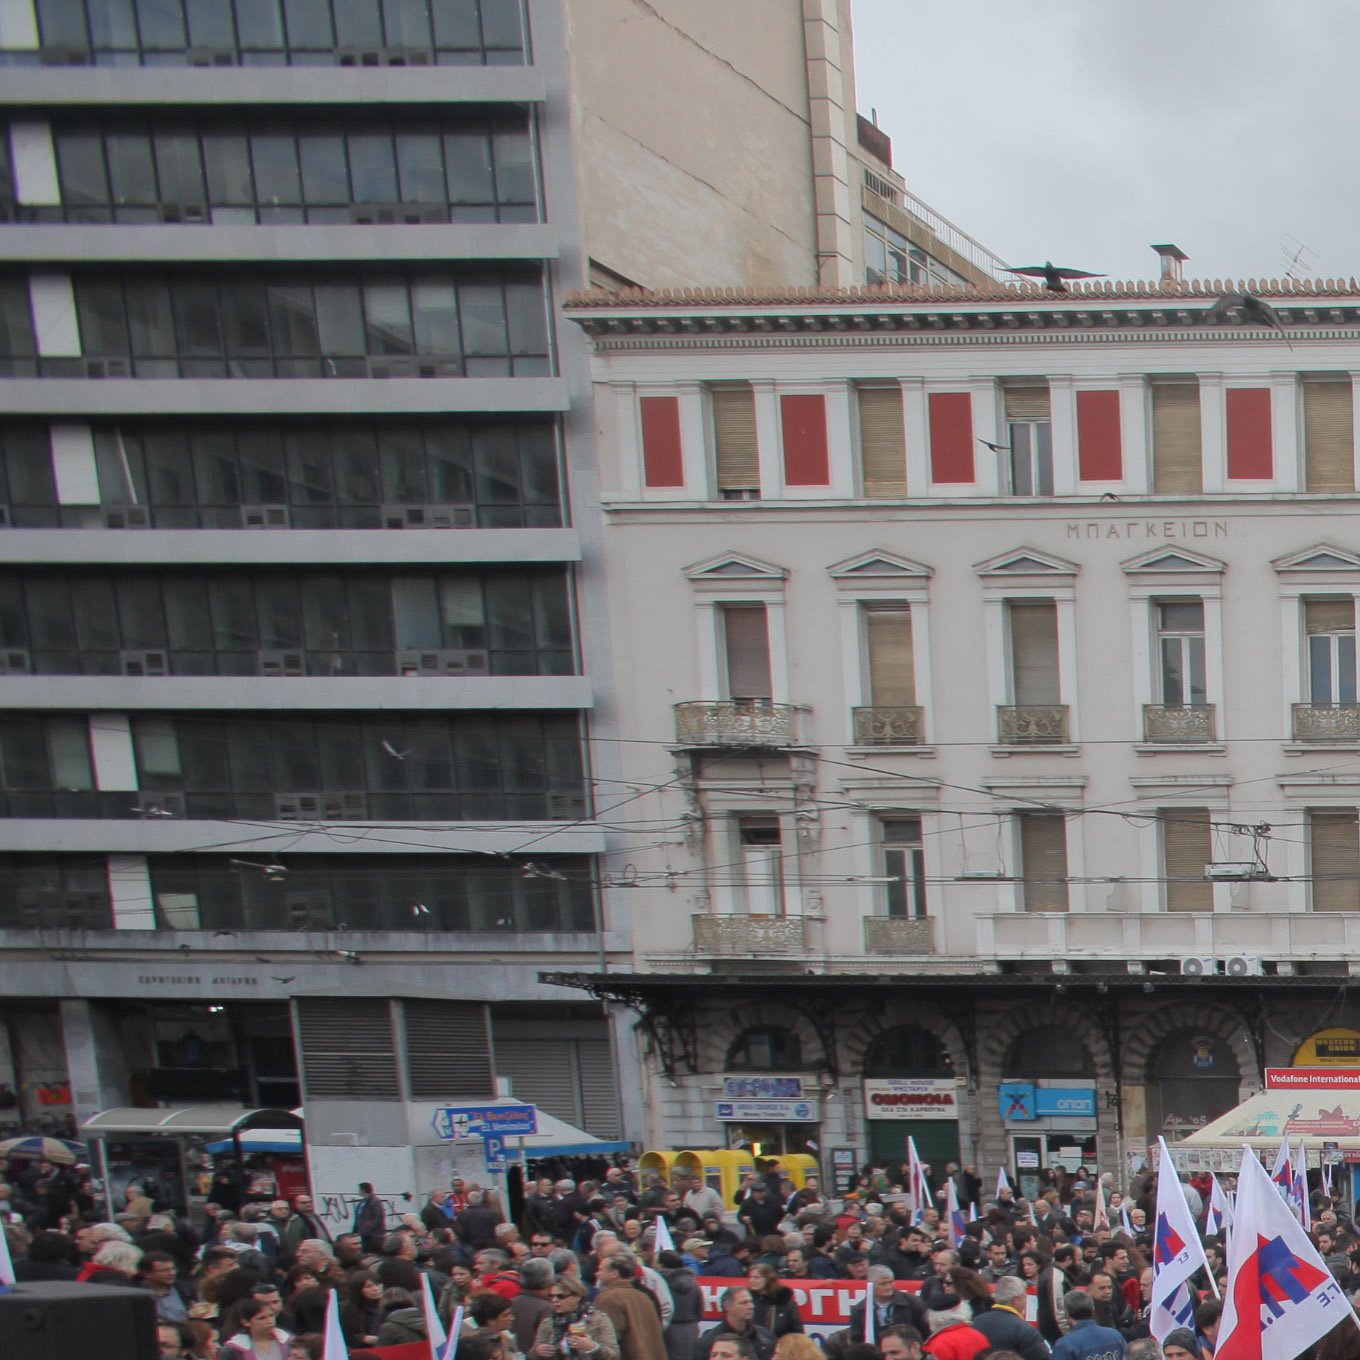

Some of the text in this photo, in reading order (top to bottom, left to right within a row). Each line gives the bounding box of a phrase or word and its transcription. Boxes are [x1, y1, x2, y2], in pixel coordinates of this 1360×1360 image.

[1067, 521, 1229, 539] ΜΠΑΓΚΕΙΟΝ
[1271, 1075, 1360, 1083] Vodafone International
